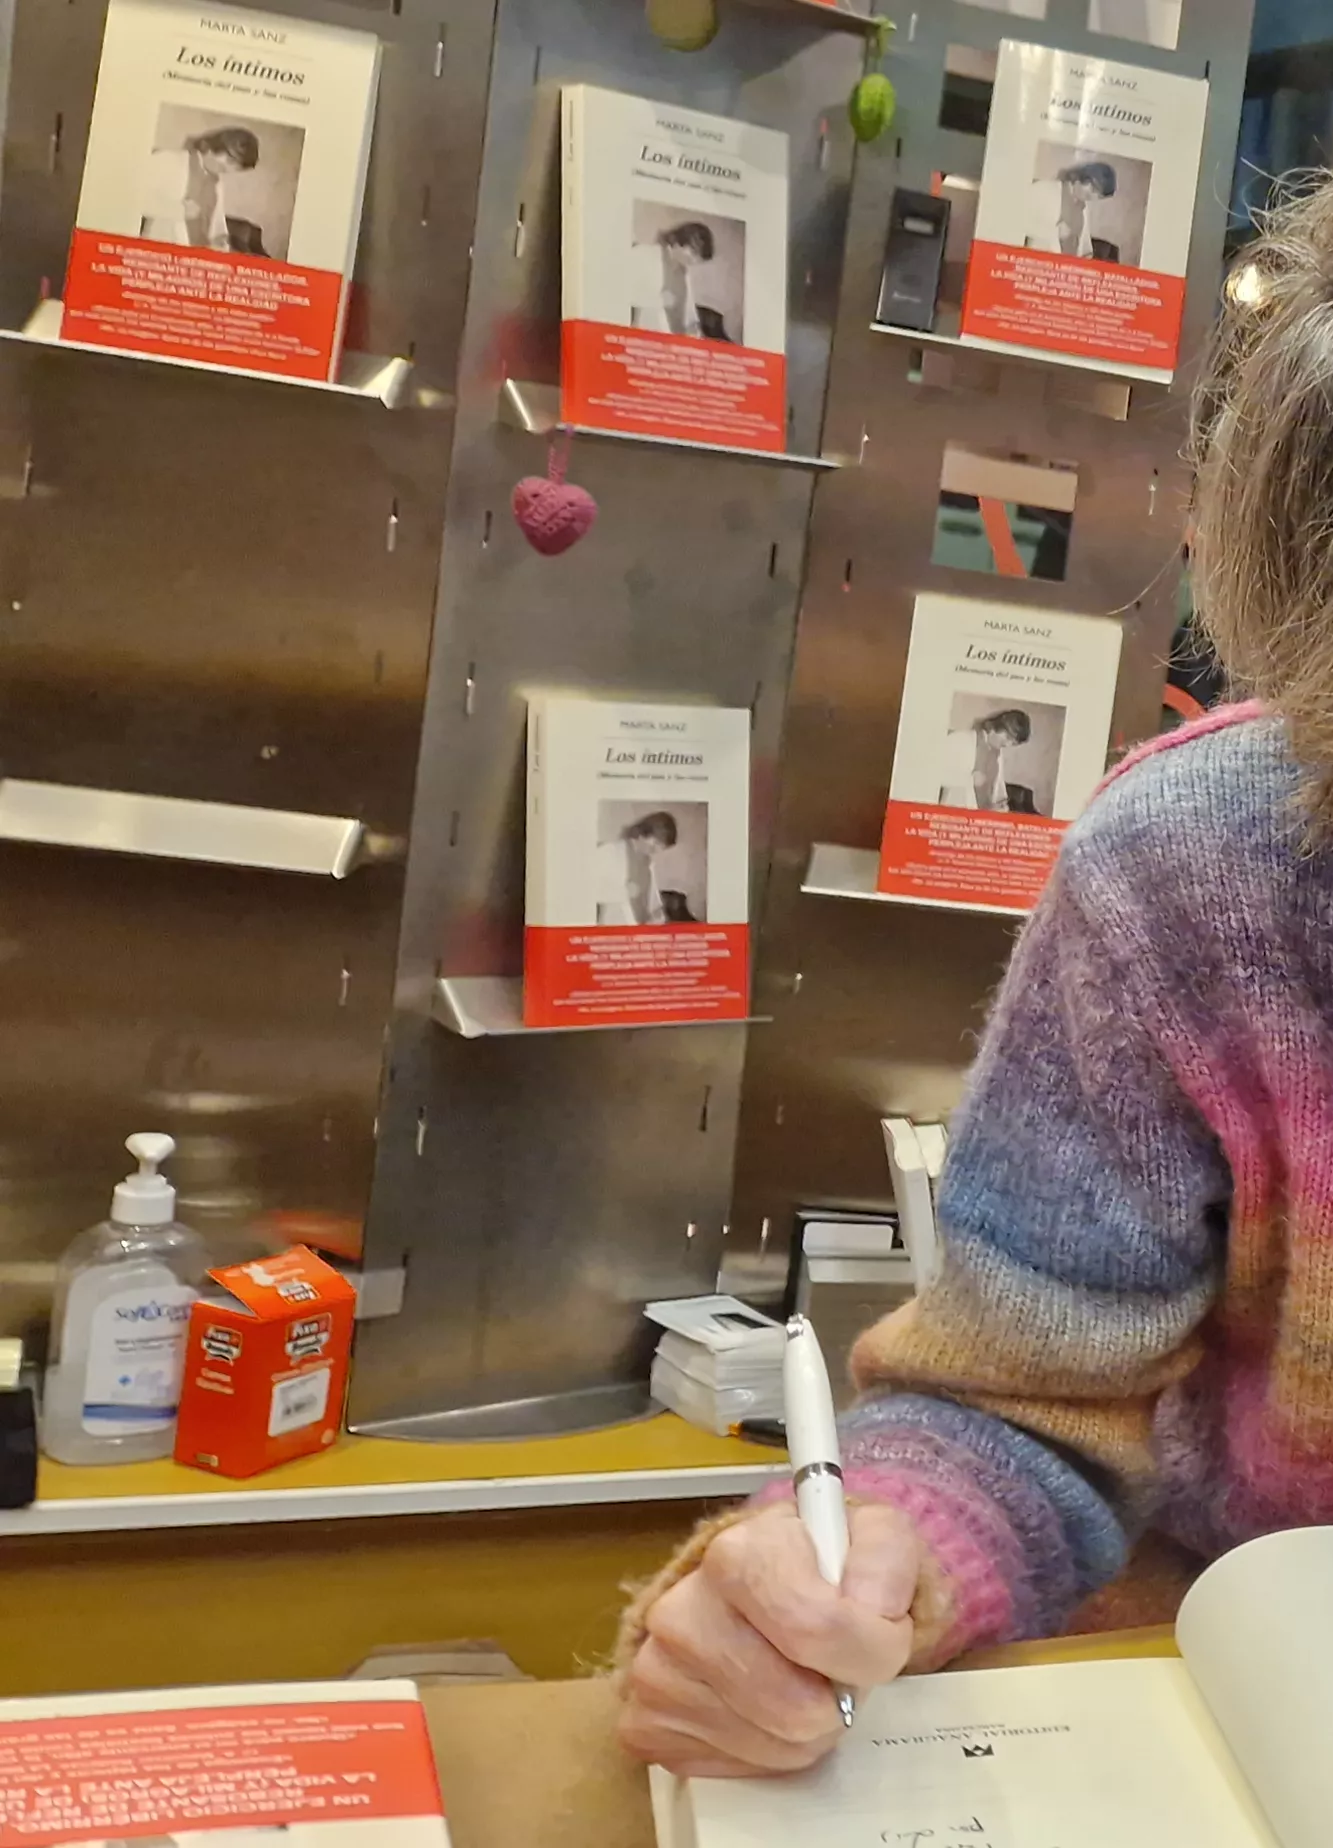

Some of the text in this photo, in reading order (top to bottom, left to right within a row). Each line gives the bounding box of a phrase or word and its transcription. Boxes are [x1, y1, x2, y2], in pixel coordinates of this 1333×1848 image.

[176, 46, 305, 86] Los íntimos
[1089, 102, 1153, 126] ntimos
[640, 145, 742, 181] Los íntimos
[984, 620, 1053, 638] MARTA SANZ
[965, 644, 1068, 672] Los íntimos
[605, 747, 637, 763] Los
[871, 1725, 1071, 1748] EDITORIAL ANAGRAMA
